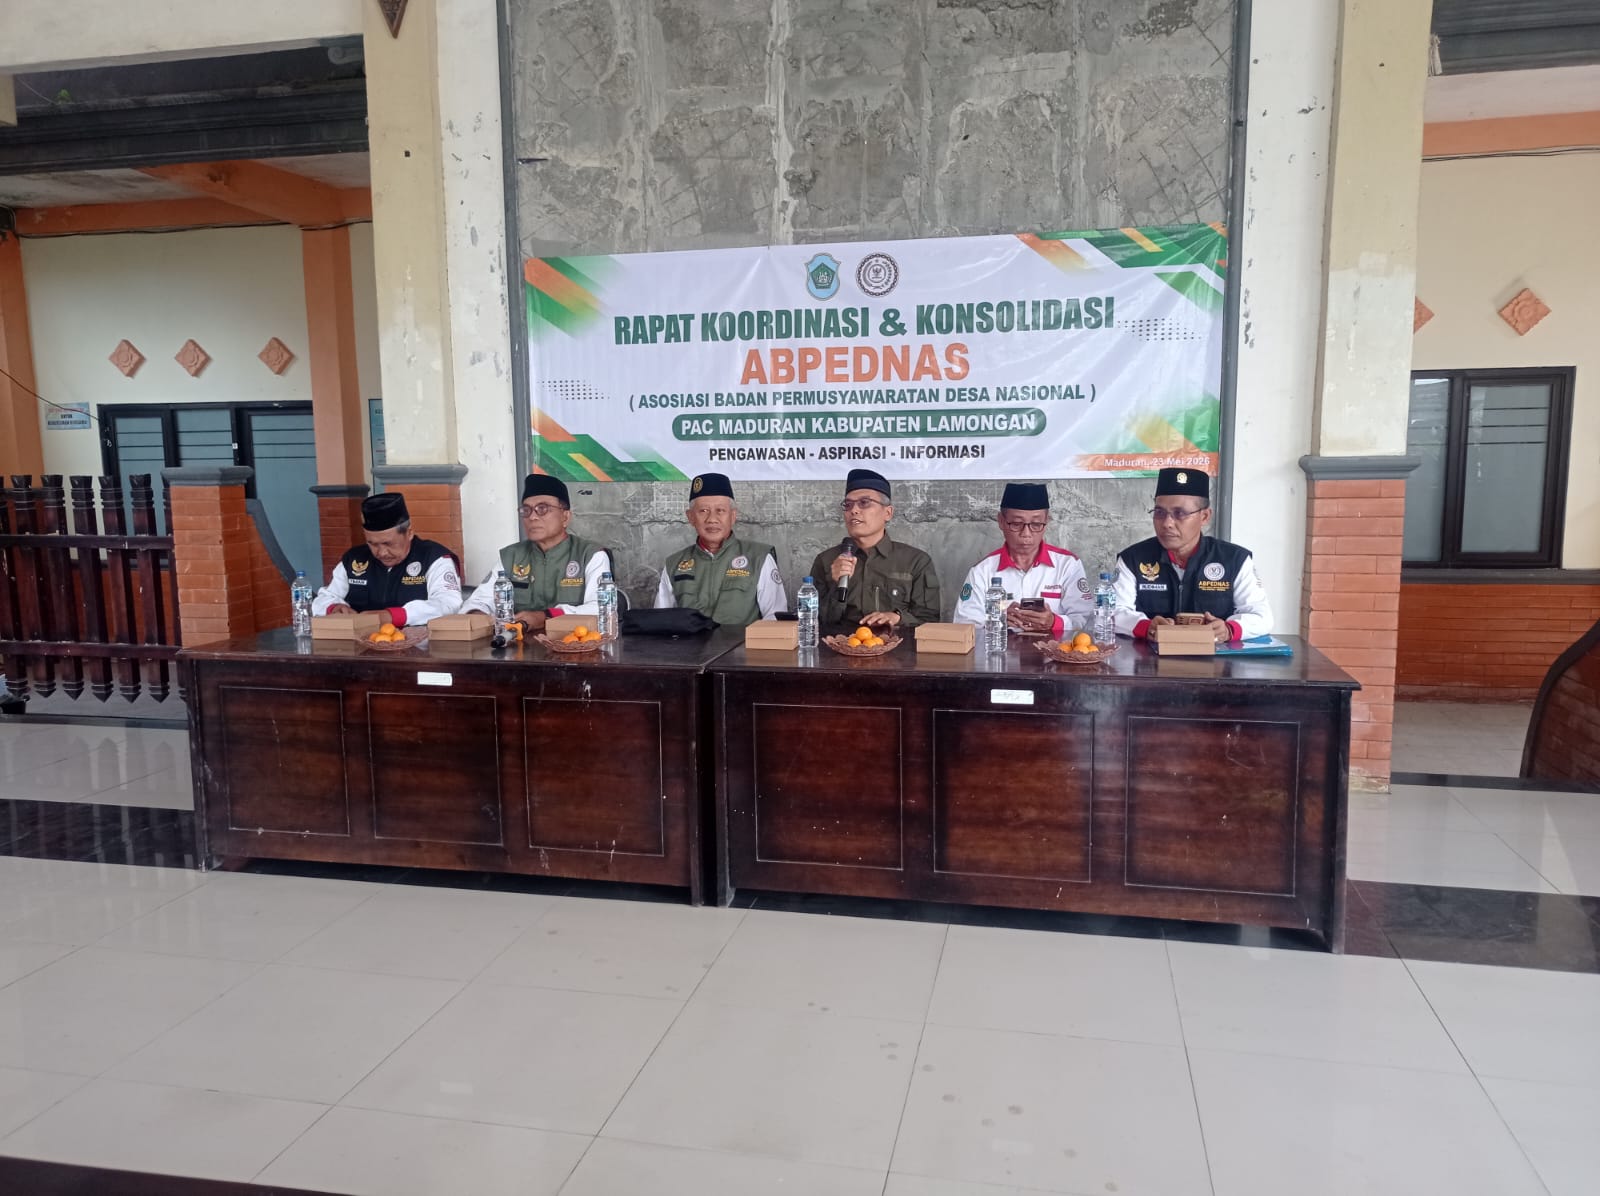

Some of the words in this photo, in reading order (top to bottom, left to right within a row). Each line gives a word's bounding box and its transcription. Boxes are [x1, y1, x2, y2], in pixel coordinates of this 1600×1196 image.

[614, 313, 695, 345] RAPAT
[702, 307, 870, 342] KOORDINASI
[879, 307, 907, 337] &
[916, 296, 1115, 336] KONSOLIDASI
[740, 342, 970, 385] ABPEDNAS
[638, 393, 710, 408] ASOSIASI
[715, 392, 767, 407] BADAN
[772, 387, 938, 406] PERMUSYAWARATAN
[946, 386, 991, 402] DESA
[996, 384, 1085, 402] NASIONAL
[682, 419, 714, 435] PAC
[719, 417, 807, 434] MADURAN
[812, 416, 920, 433] KABUPATEN
[927, 413, 1036, 432] LAMONGAN
[710, 447, 806, 461] PENGAWASAN
[818, 446, 886, 460] ASPIRASI
[900, 445, 985, 460] INFORMASI
[1187, 457, 1210, 465] 2026
